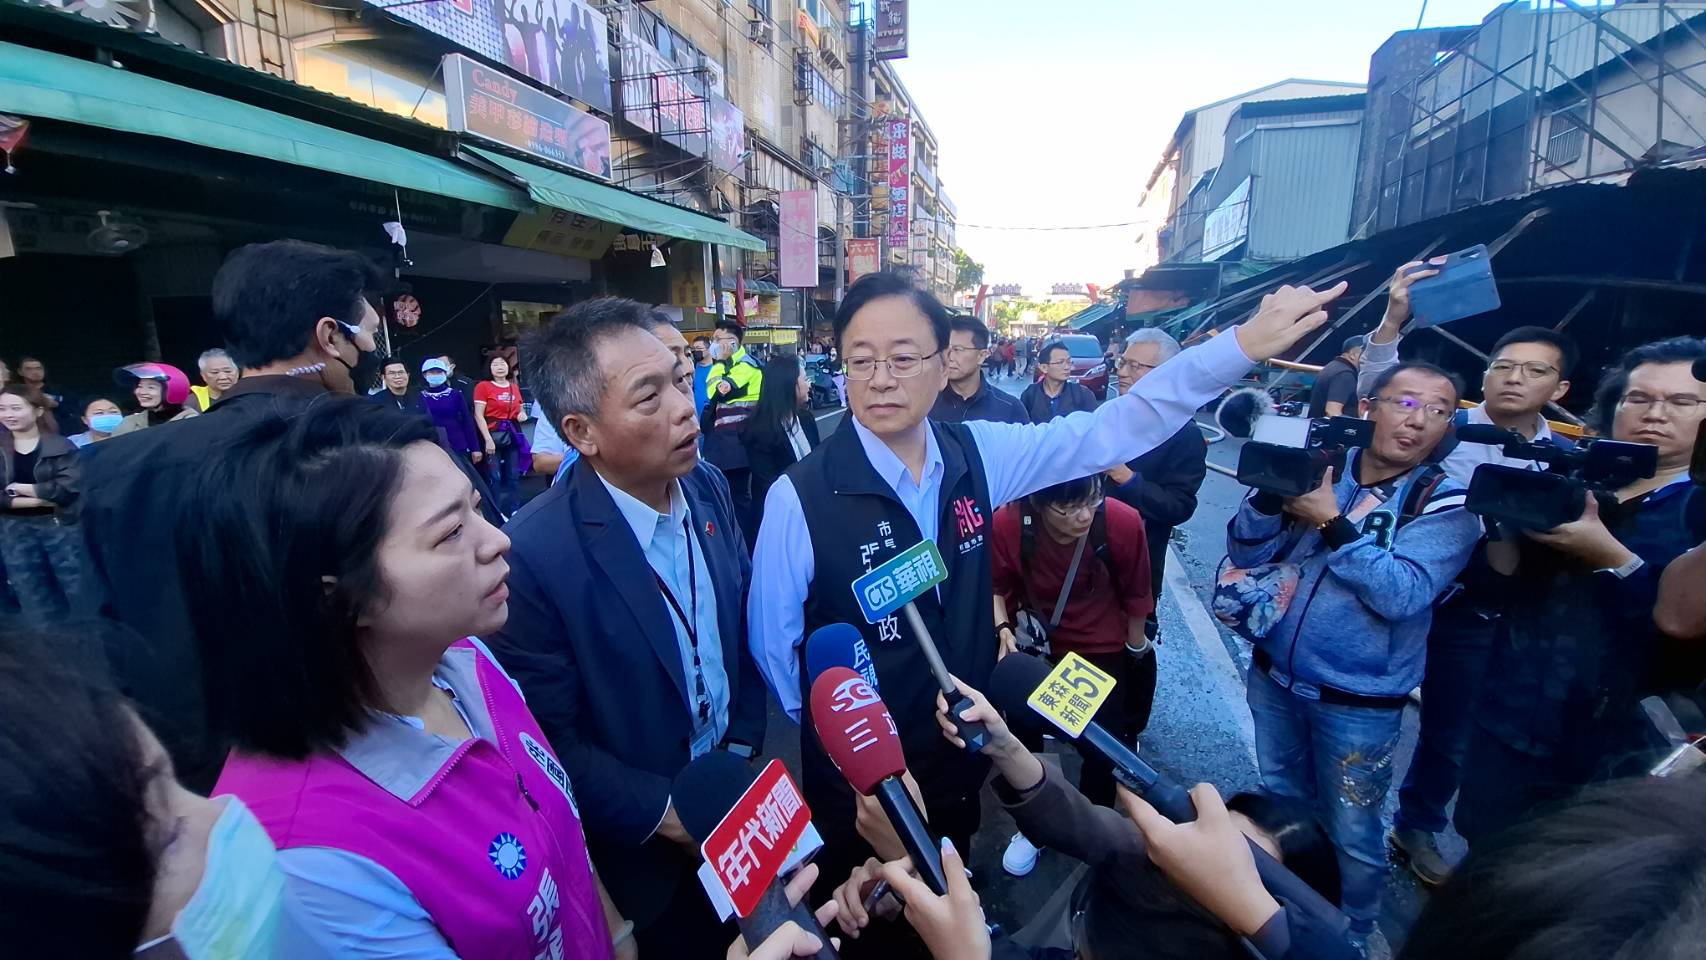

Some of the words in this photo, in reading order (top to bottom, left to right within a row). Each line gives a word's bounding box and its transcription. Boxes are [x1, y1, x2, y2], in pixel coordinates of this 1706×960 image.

[472, 69, 518, 105] Candy
[849, 242, 875, 254] 六六
[1360, 509, 1397, 552] R
[867, 577, 896, 608] CTS
[892, 549, 940, 595] 華視
[1039, 680, 1071, 711] 東森
[1059, 658, 1108, 699] 51
[1058, 693, 1093, 727] 新聞
[718, 773, 803, 892] 年代新聞
